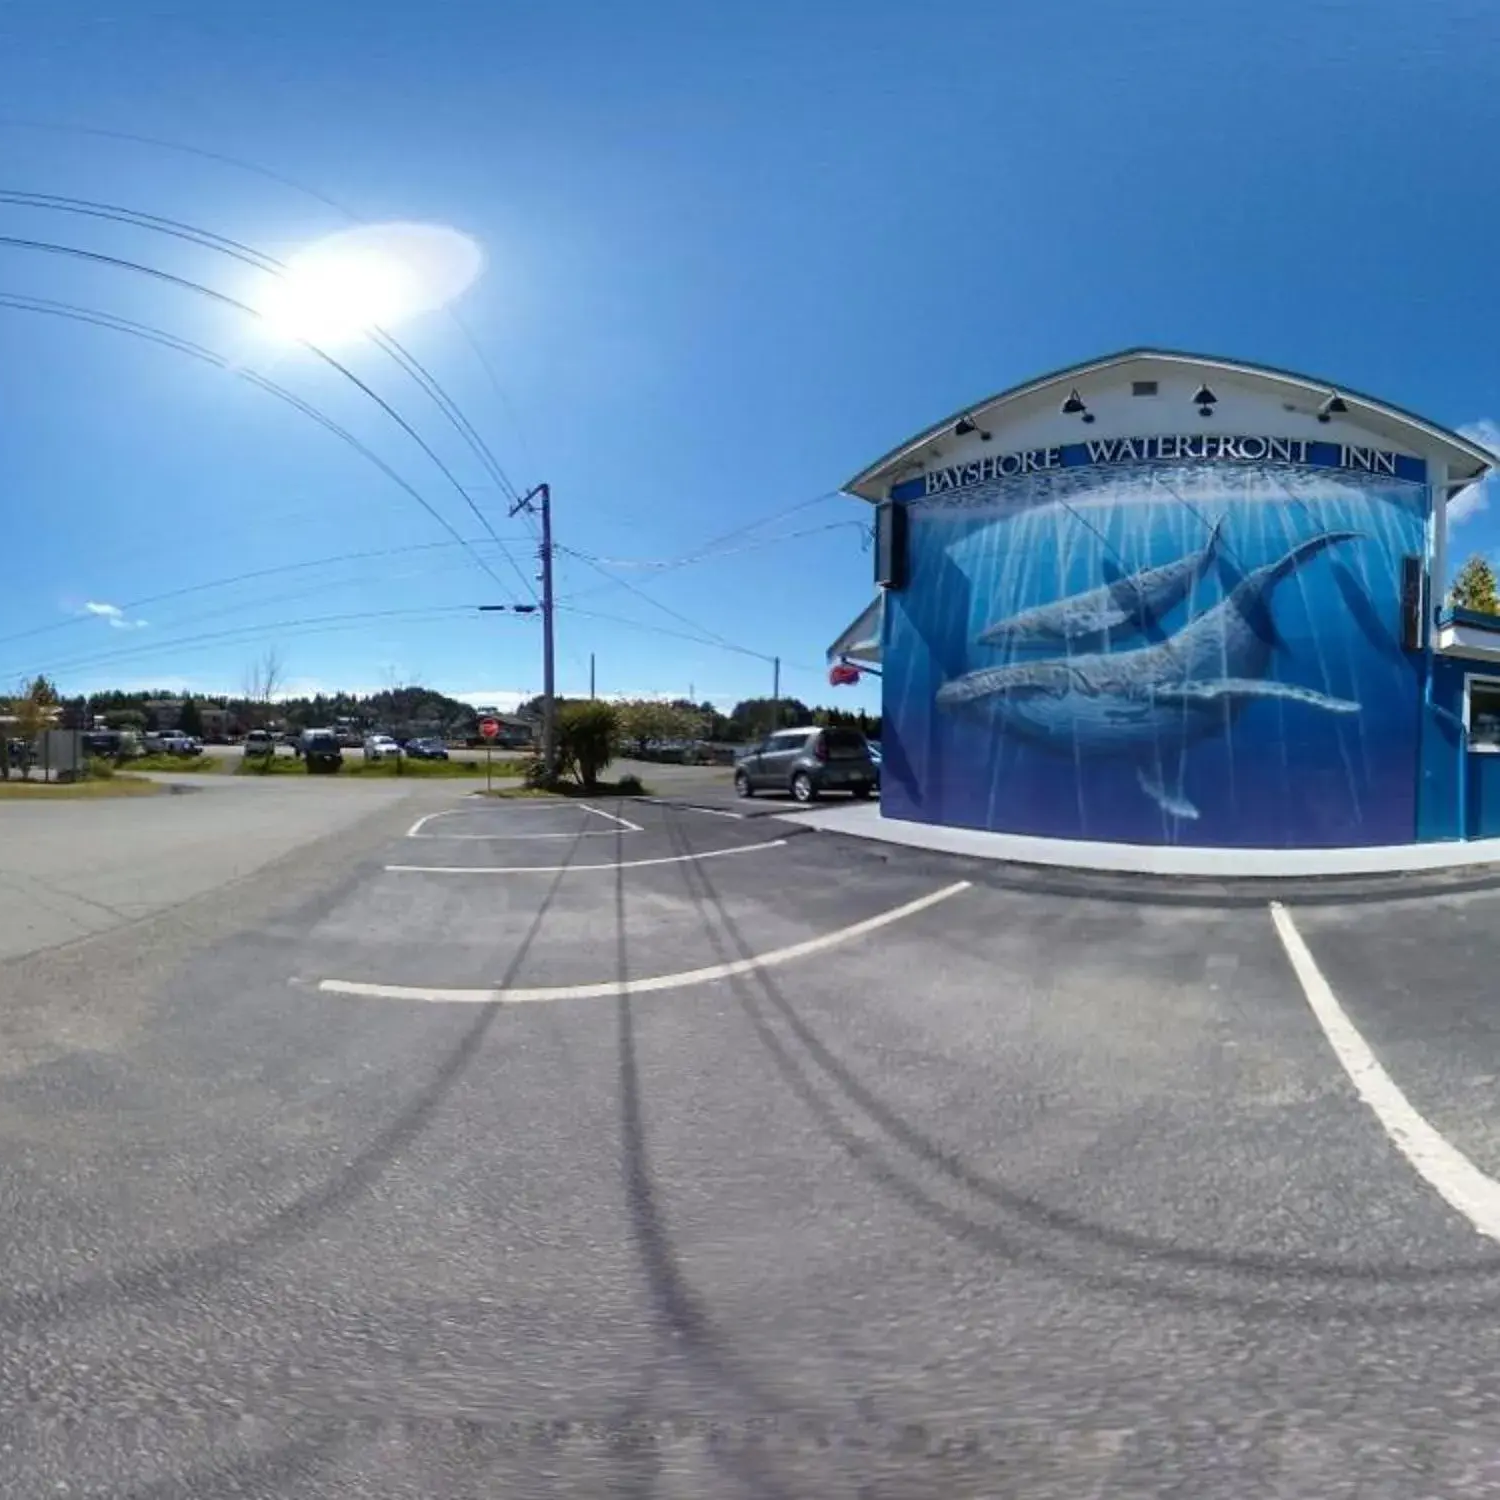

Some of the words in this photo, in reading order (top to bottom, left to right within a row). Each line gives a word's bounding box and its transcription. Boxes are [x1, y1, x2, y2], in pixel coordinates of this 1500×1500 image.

[925, 448, 1060, 495] BAYSHORE
[1085, 435, 1313, 463] WATERFRONT
[1340, 444, 1396, 474] INN
